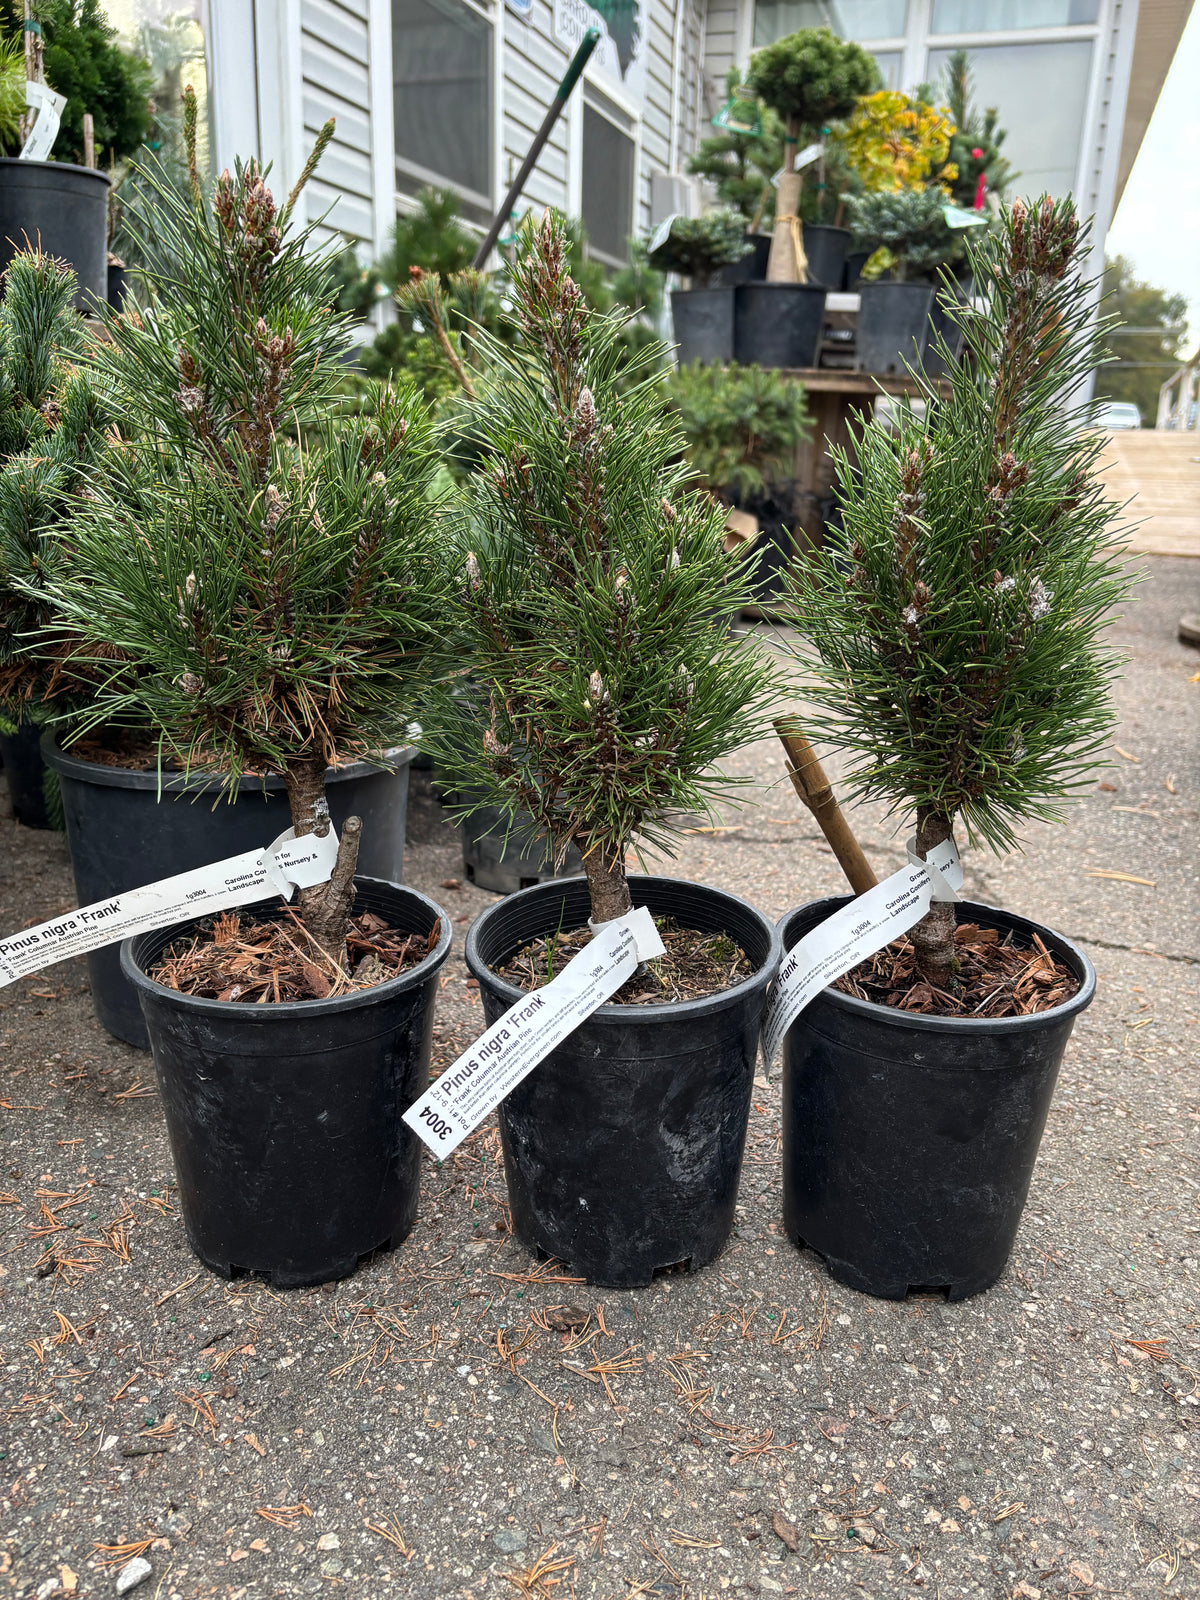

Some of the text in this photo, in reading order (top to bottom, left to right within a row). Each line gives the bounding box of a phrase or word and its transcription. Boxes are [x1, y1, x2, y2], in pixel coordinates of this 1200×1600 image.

[224, 873, 254, 885] Carolina
[284, 856, 311, 868] Nursery
[228, 878, 264, 892] Landscape
[885, 892, 911, 910] Carolina
[890, 895, 920, 917] Landscape
[0, 899, 121, 955] Pinus nigra 'Frank'
[27, 940, 58, 954] Columnar
[58, 930, 84, 942] Austrian
[82, 924, 98, 934] Pine
[851, 920, 871, 935] 1g3004
[775, 954, 799, 988] 'Frank'
[441, 994, 546, 1096] Pinus nigra 'Frank'
[452, 1028, 532, 1105] 'Frank' Columnar Austrian Pine
[470, 1102, 490, 1121] Grown
[489, 1094, 498, 1103] by
[419, 1106, 452, 1140] 3004
[457, 1116, 471, 1131] Pot
